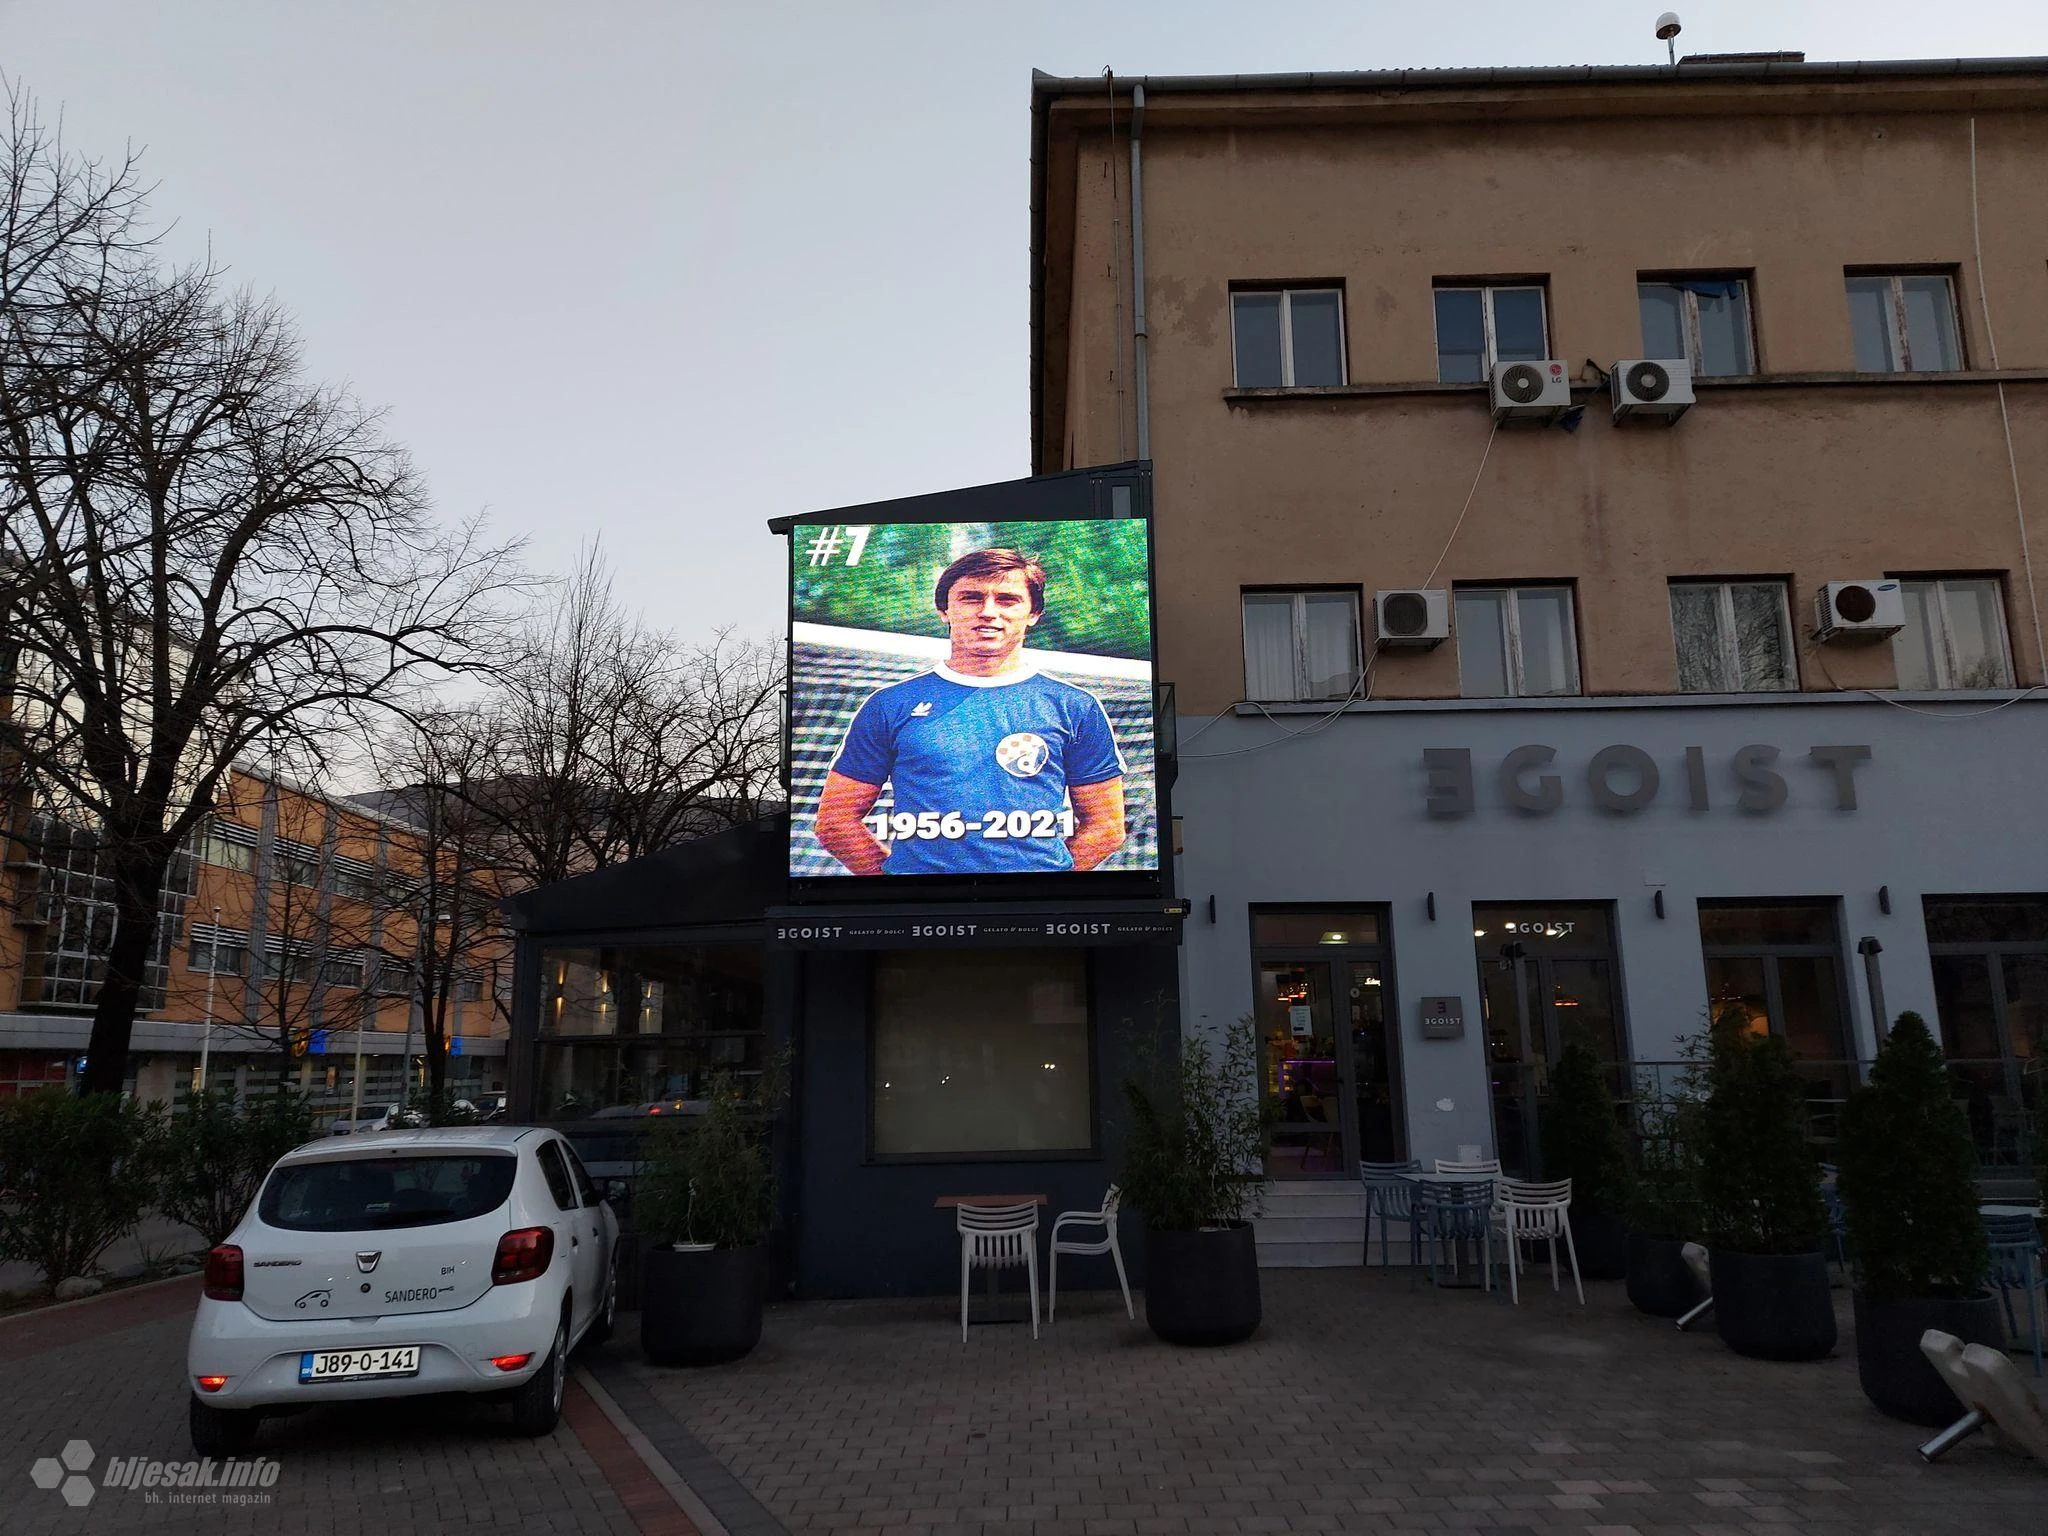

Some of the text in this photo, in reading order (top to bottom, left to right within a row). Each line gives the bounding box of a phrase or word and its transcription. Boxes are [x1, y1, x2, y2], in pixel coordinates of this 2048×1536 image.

[1551, 376, 1562, 384] LG
[805, 526, 871, 567] #7
[871, 810, 1075, 841] 1956-2021
[385, 1287, 437, 1304] SANDERO
